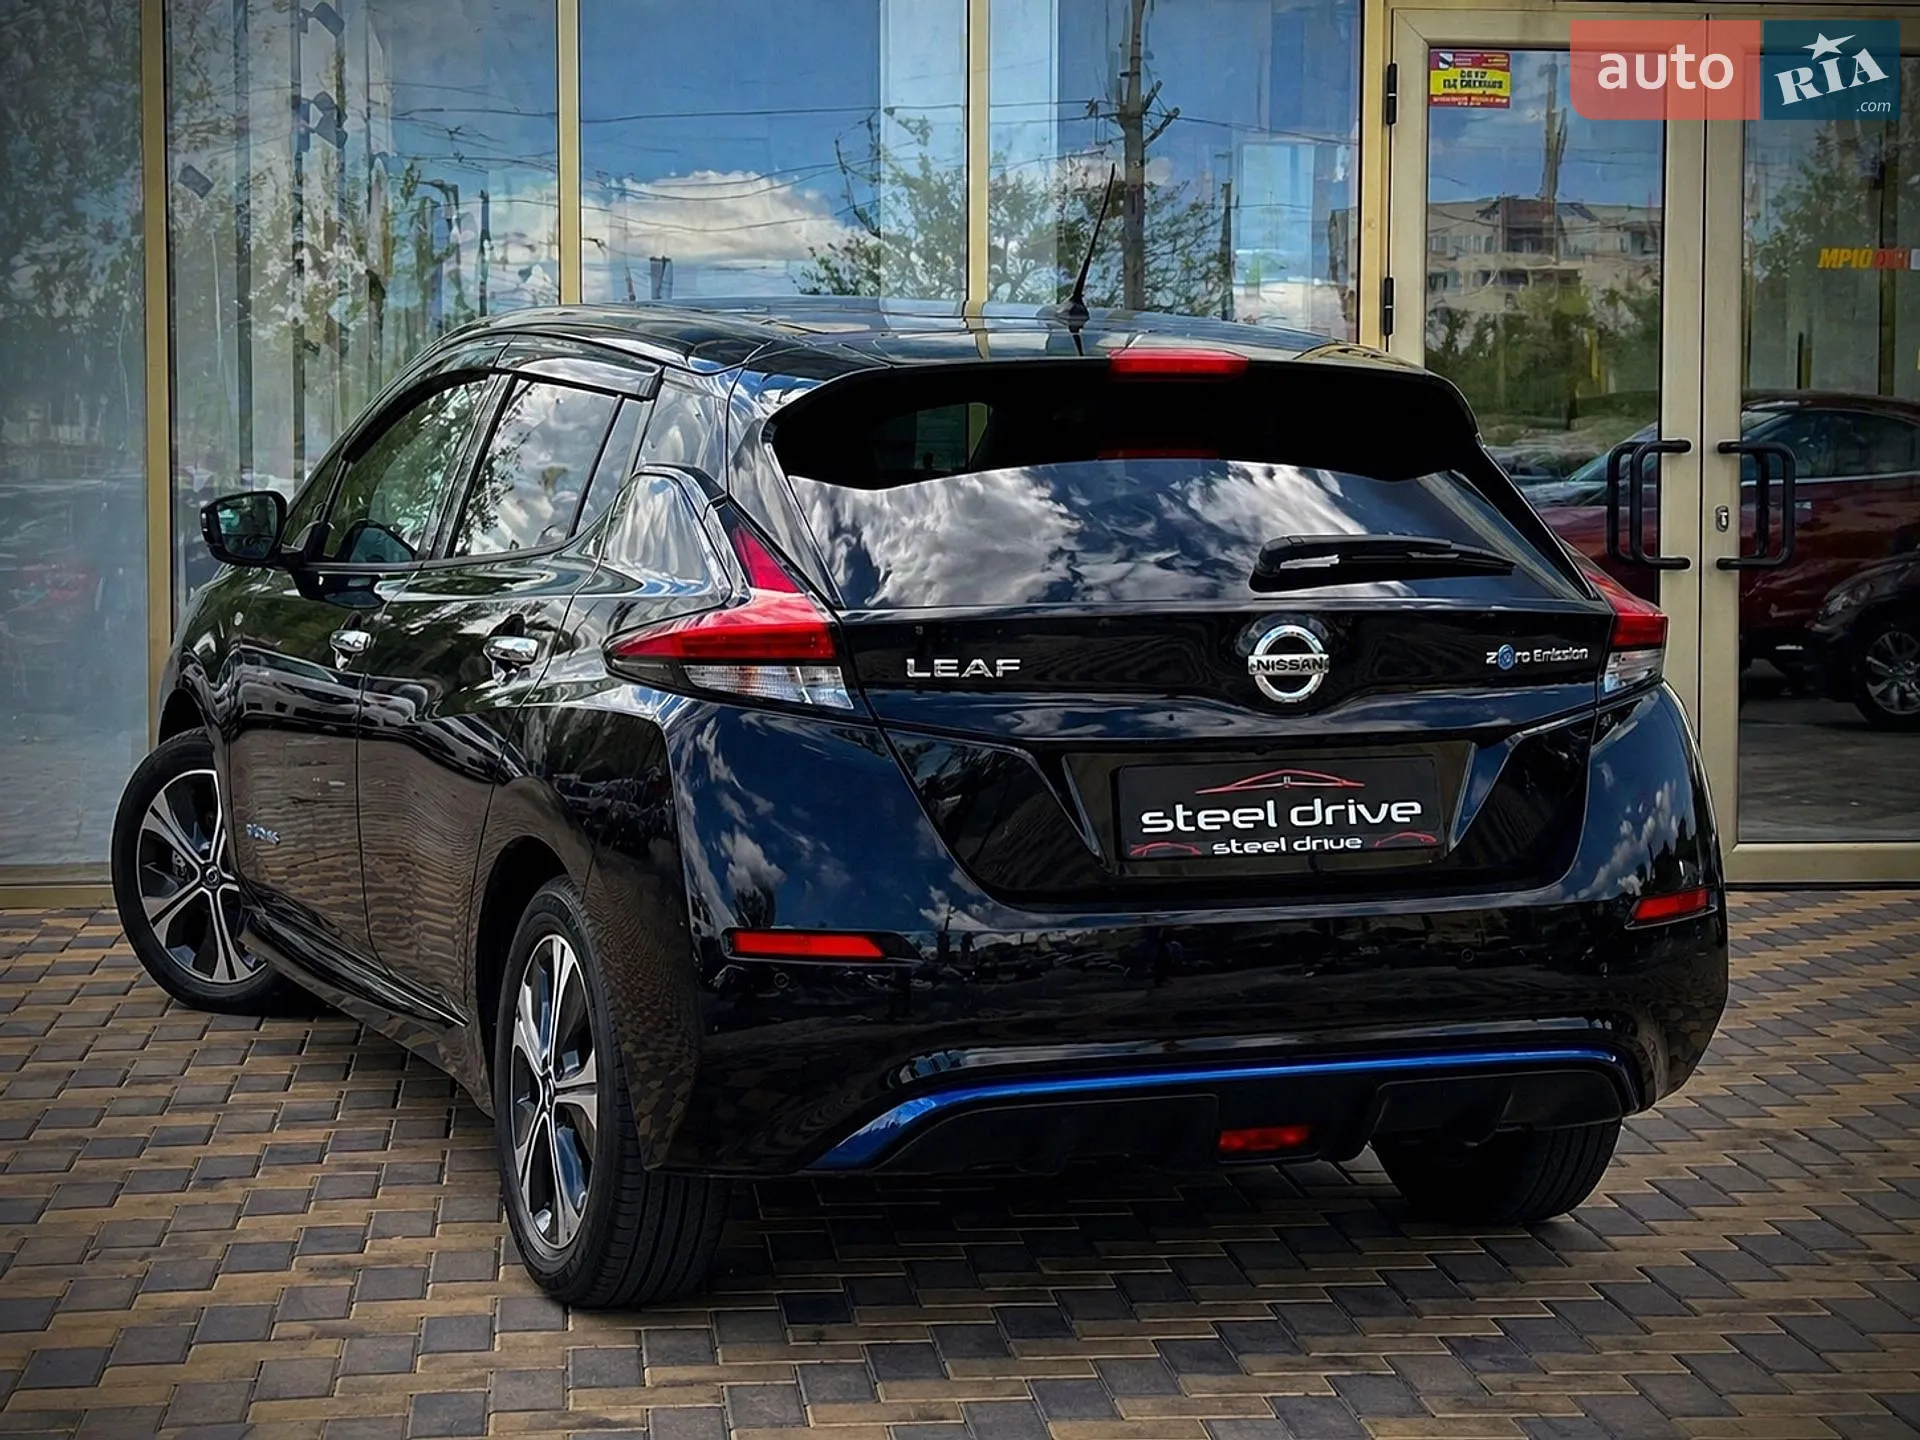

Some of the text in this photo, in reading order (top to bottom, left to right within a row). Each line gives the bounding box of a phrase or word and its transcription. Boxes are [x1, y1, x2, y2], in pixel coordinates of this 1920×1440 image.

[905, 658, 1021, 678] LEAF
[1256, 657, 1325, 671] NISSAN
[1140, 798, 1422, 834] steel drive
[1212, 835, 1363, 855] steel drive
